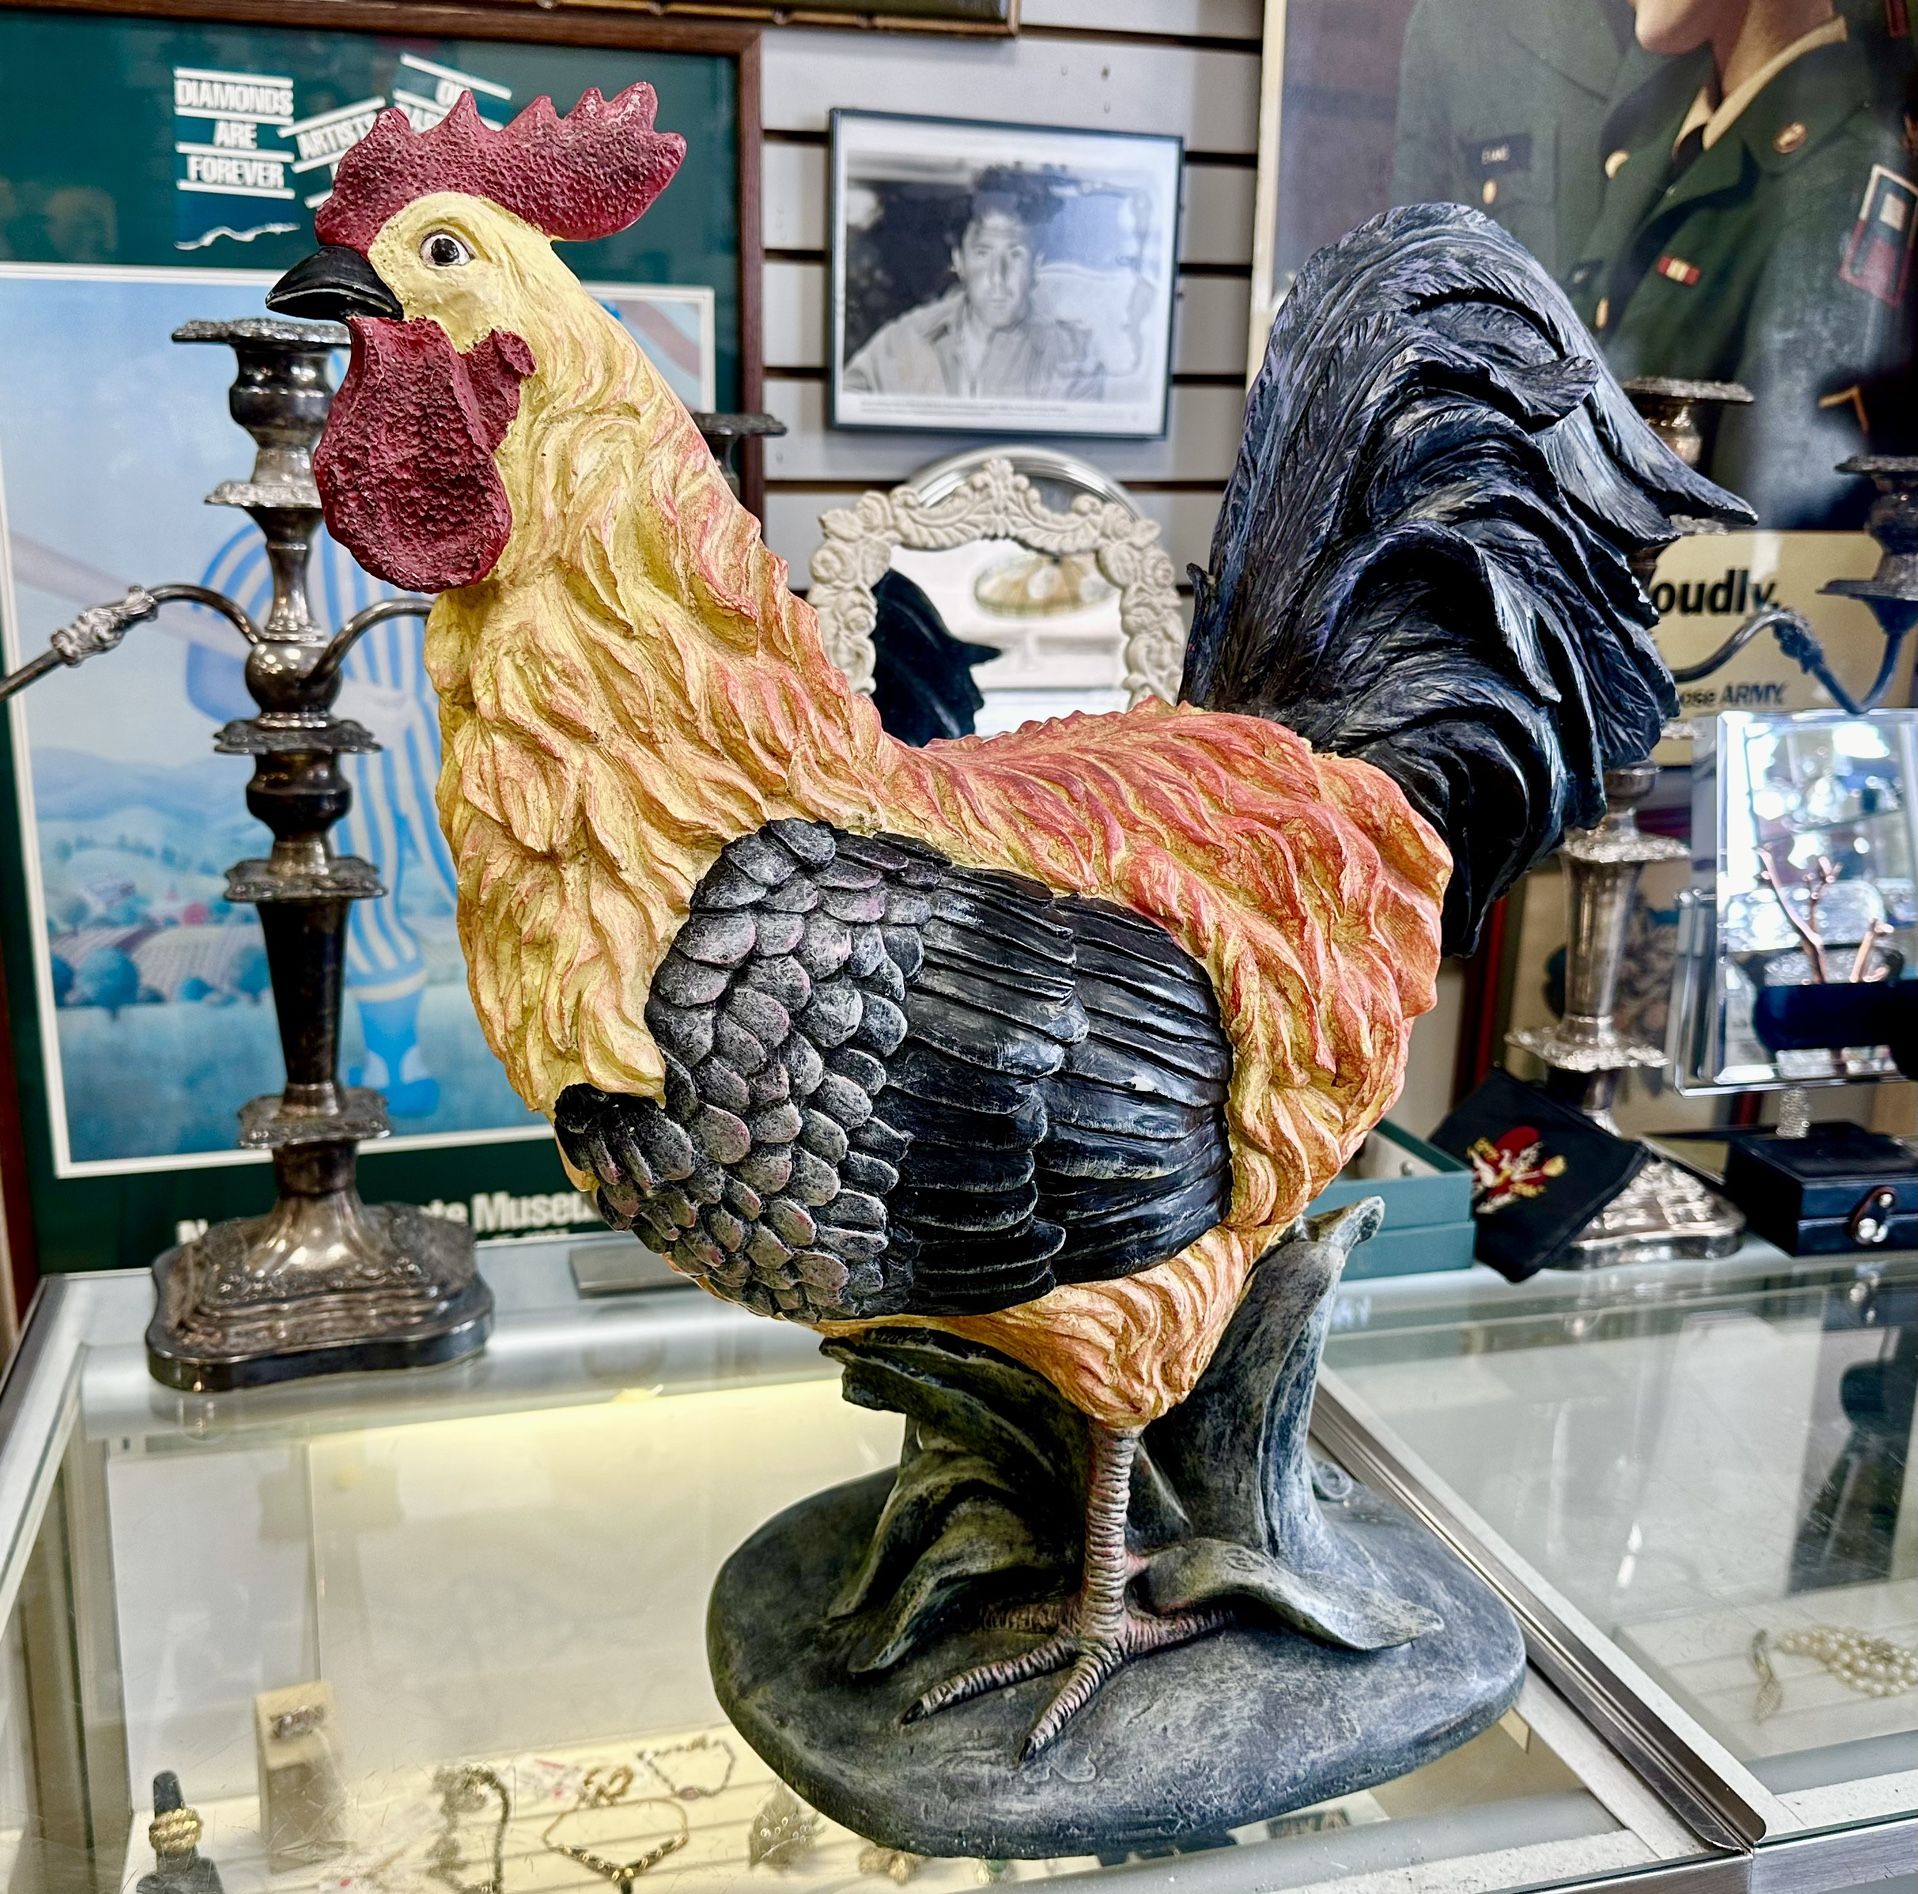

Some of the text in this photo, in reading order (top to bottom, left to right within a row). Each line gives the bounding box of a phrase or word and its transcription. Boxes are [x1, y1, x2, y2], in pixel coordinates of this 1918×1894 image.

[174, 79, 294, 116] DIAMONDS
[213, 119, 258, 150] ARE
[187, 154, 285, 190] FOREVER
[1652, 568, 1780, 613] oudly.
